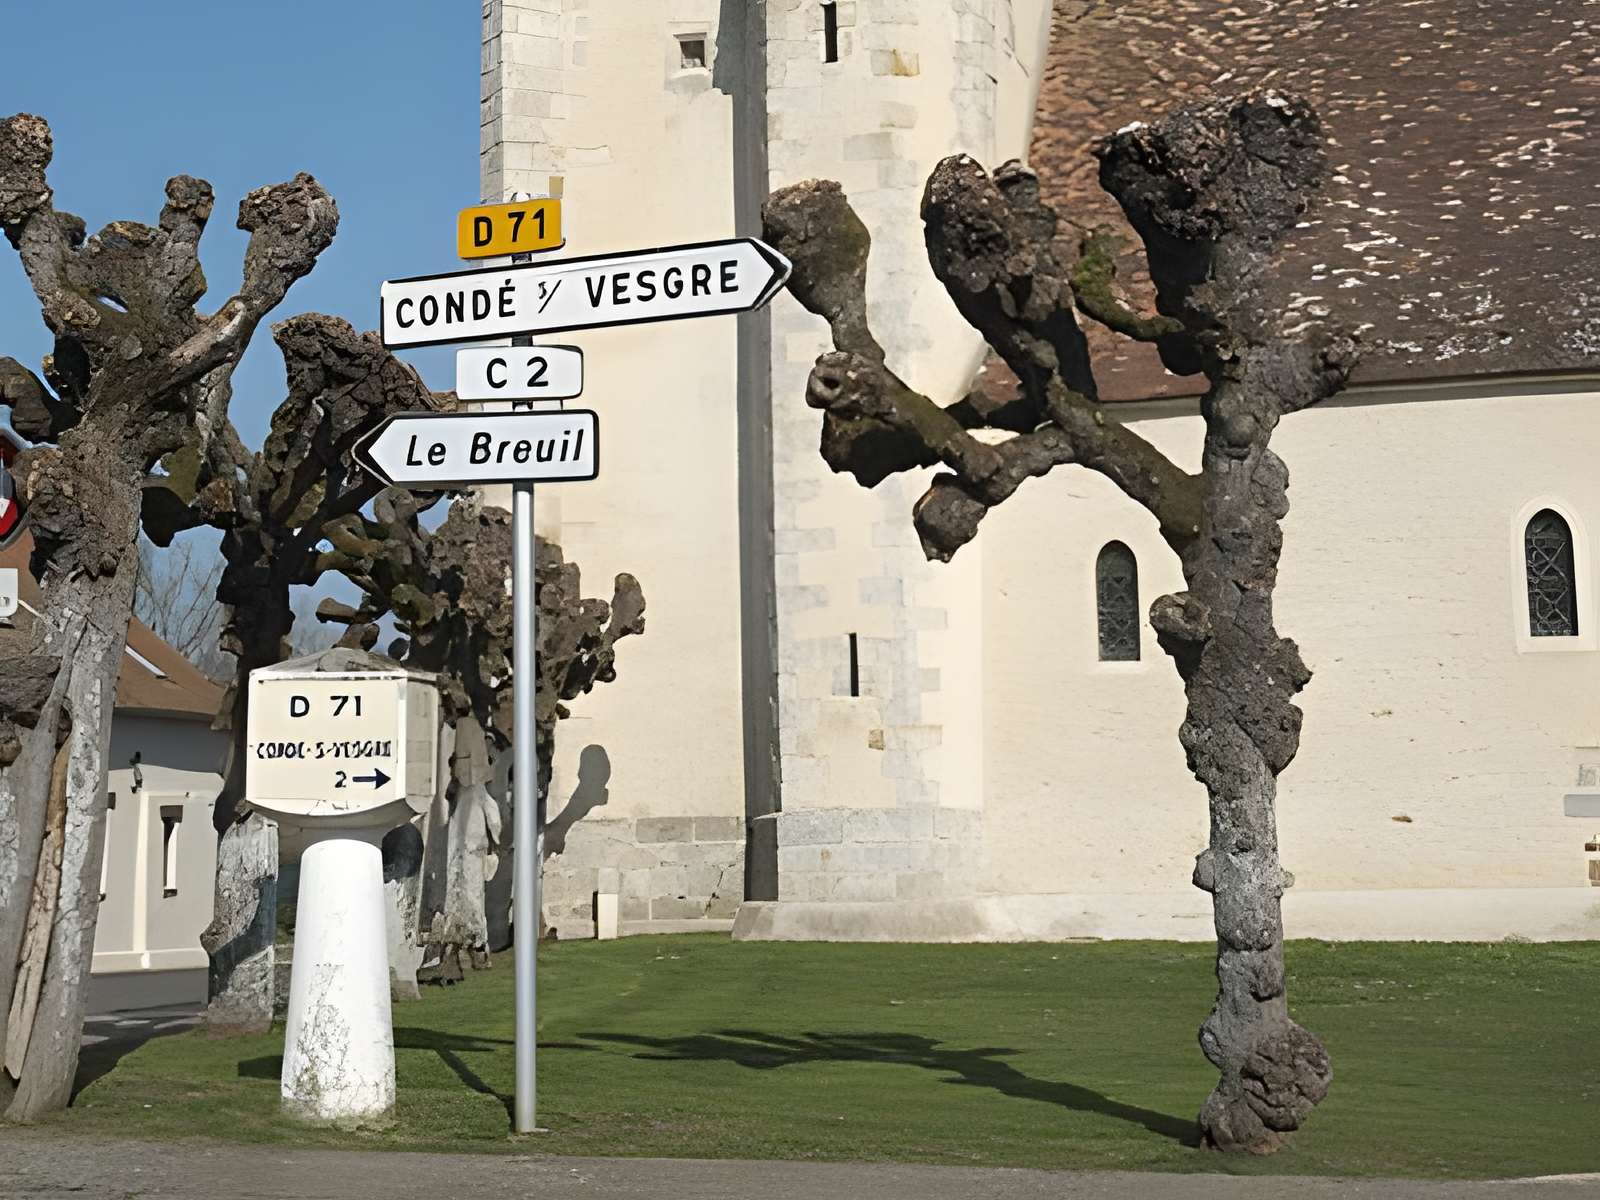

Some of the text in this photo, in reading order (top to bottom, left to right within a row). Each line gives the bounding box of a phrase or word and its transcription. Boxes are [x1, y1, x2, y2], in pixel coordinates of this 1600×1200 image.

[473, 207, 546, 248] D 71
[396, 278, 517, 329] CONDÉ
[584, 259, 739, 308] VESGRE
[486, 356, 549, 389] C 2
[406, 428, 584, 467] Le Breuil
[290, 695, 362, 718] D 71
[334, 770, 347, 789] 2
